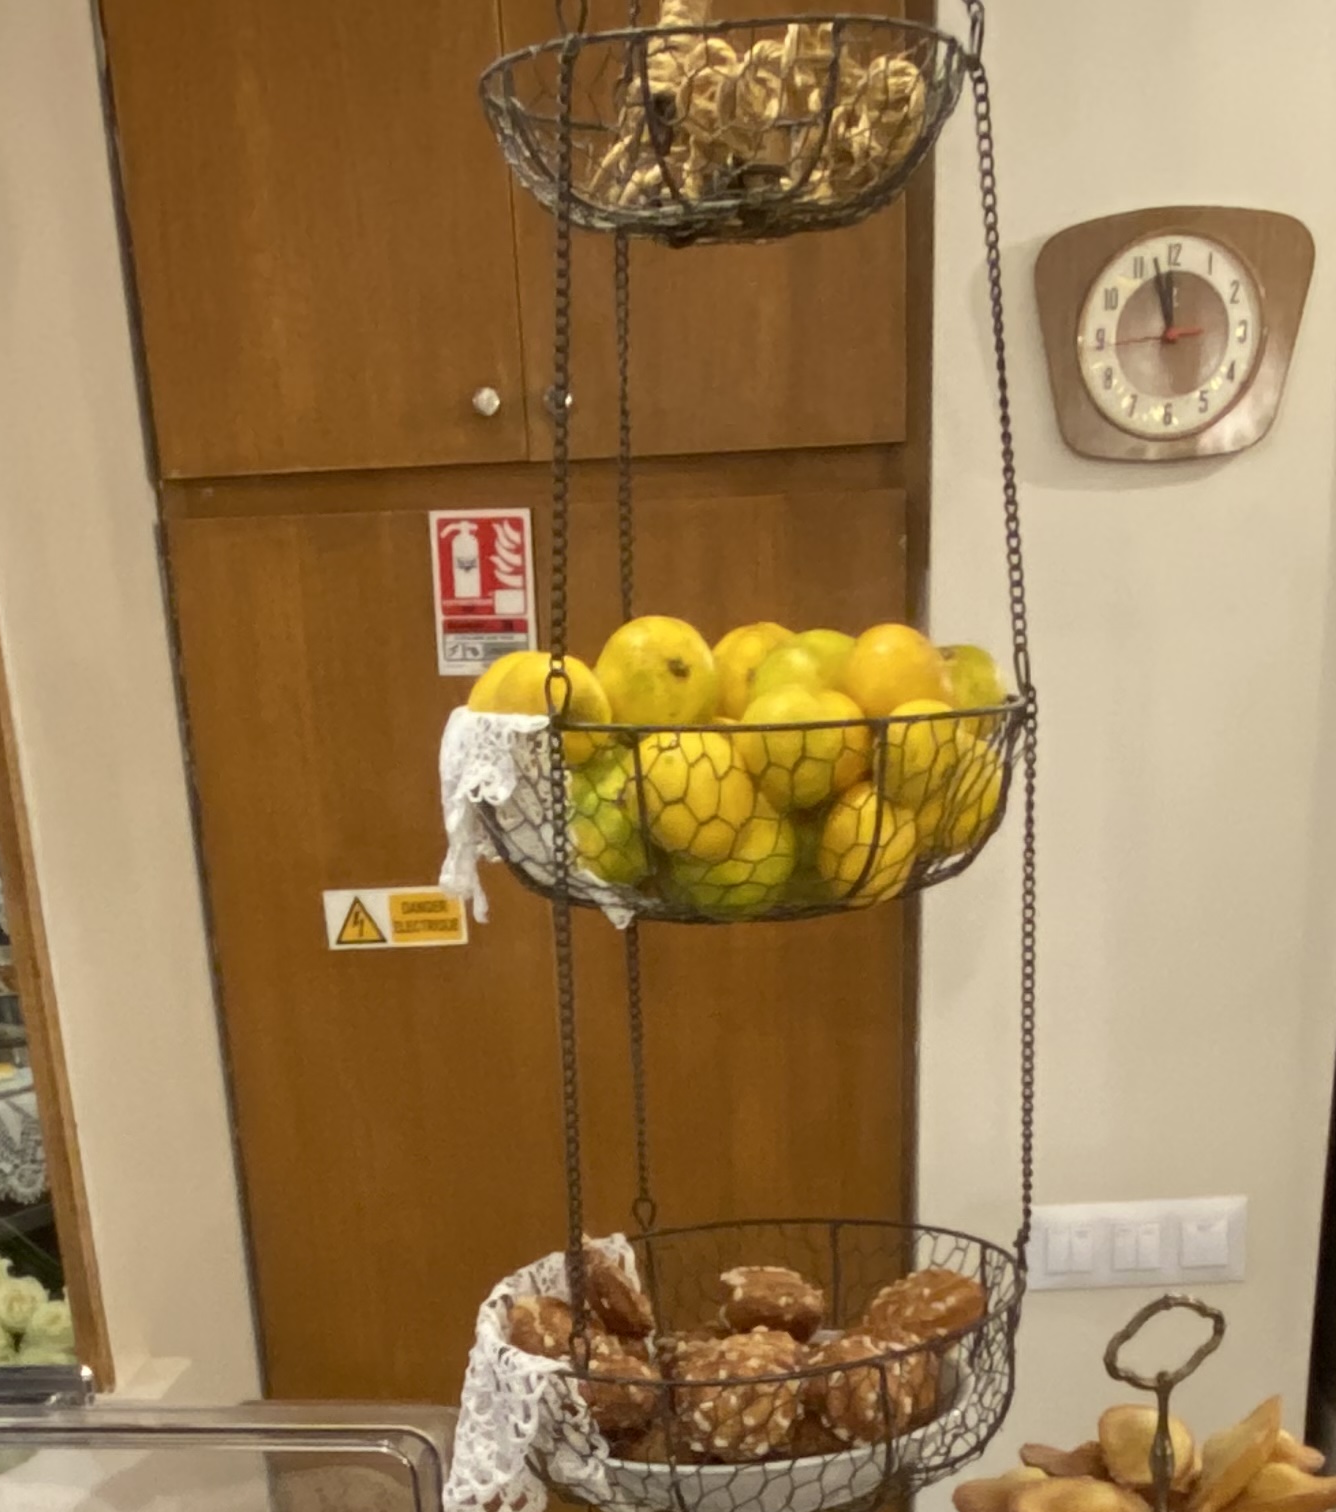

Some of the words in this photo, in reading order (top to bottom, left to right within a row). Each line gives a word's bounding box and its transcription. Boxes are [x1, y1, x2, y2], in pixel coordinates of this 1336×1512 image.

[1167, 243, 1181, 266] 12
[1208, 252, 1213, 275] 1
[1133, 256, 1144, 278] 11
[1104, 288, 1119, 310] 10
[1229, 281, 1240, 304] 2
[1096, 328, 1105, 351] 9
[1236, 320, 1248, 343] 3
[1103, 367, 1112, 389] 8
[1227, 361, 1235, 381] 4
[1129, 394, 1137, 417] 7
[1199, 390, 1209, 413] 5
[1163, 403, 1173, 425] 6
